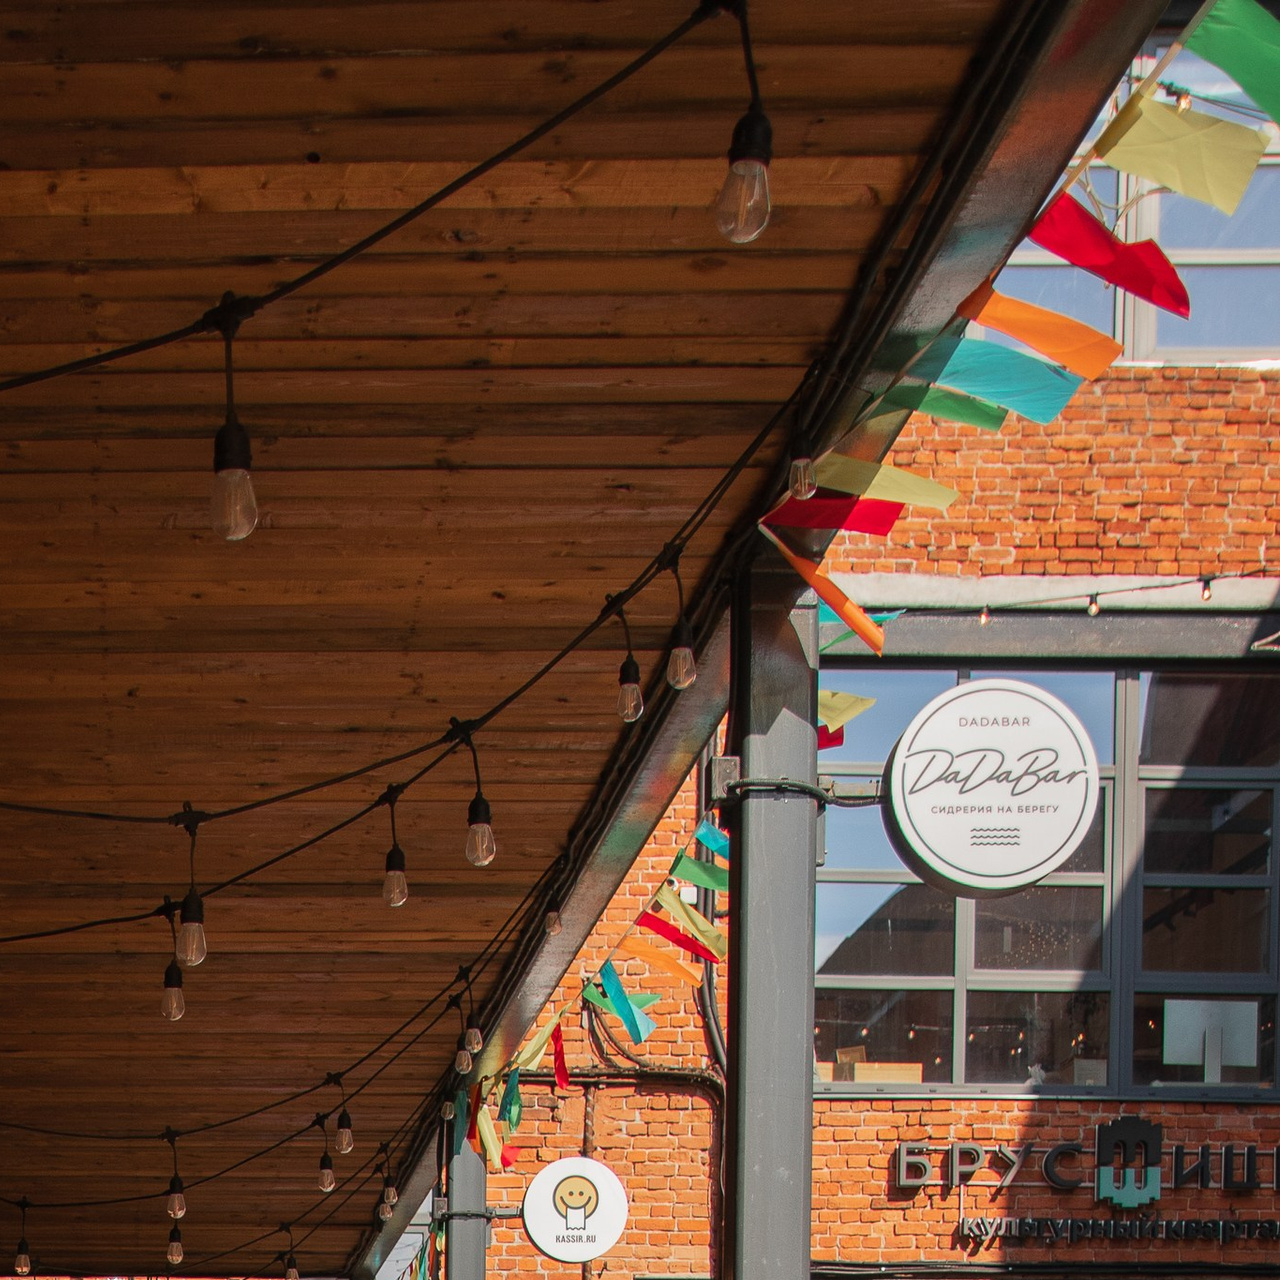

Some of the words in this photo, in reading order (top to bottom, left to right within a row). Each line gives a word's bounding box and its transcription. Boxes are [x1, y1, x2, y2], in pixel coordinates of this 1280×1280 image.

[958, 716, 1031, 728] DADABAR
[905, 747, 1088, 797] DaDaBar
[931, 805, 992, 815] СИДРЕРИЯ
[997, 805, 1013, 814] НА
[1017, 805, 1060, 814] БЕРЕГУ
[961, 1213, 1162, 1244] культурный
[555, 1234, 597, 1244] KASSIR.RU
